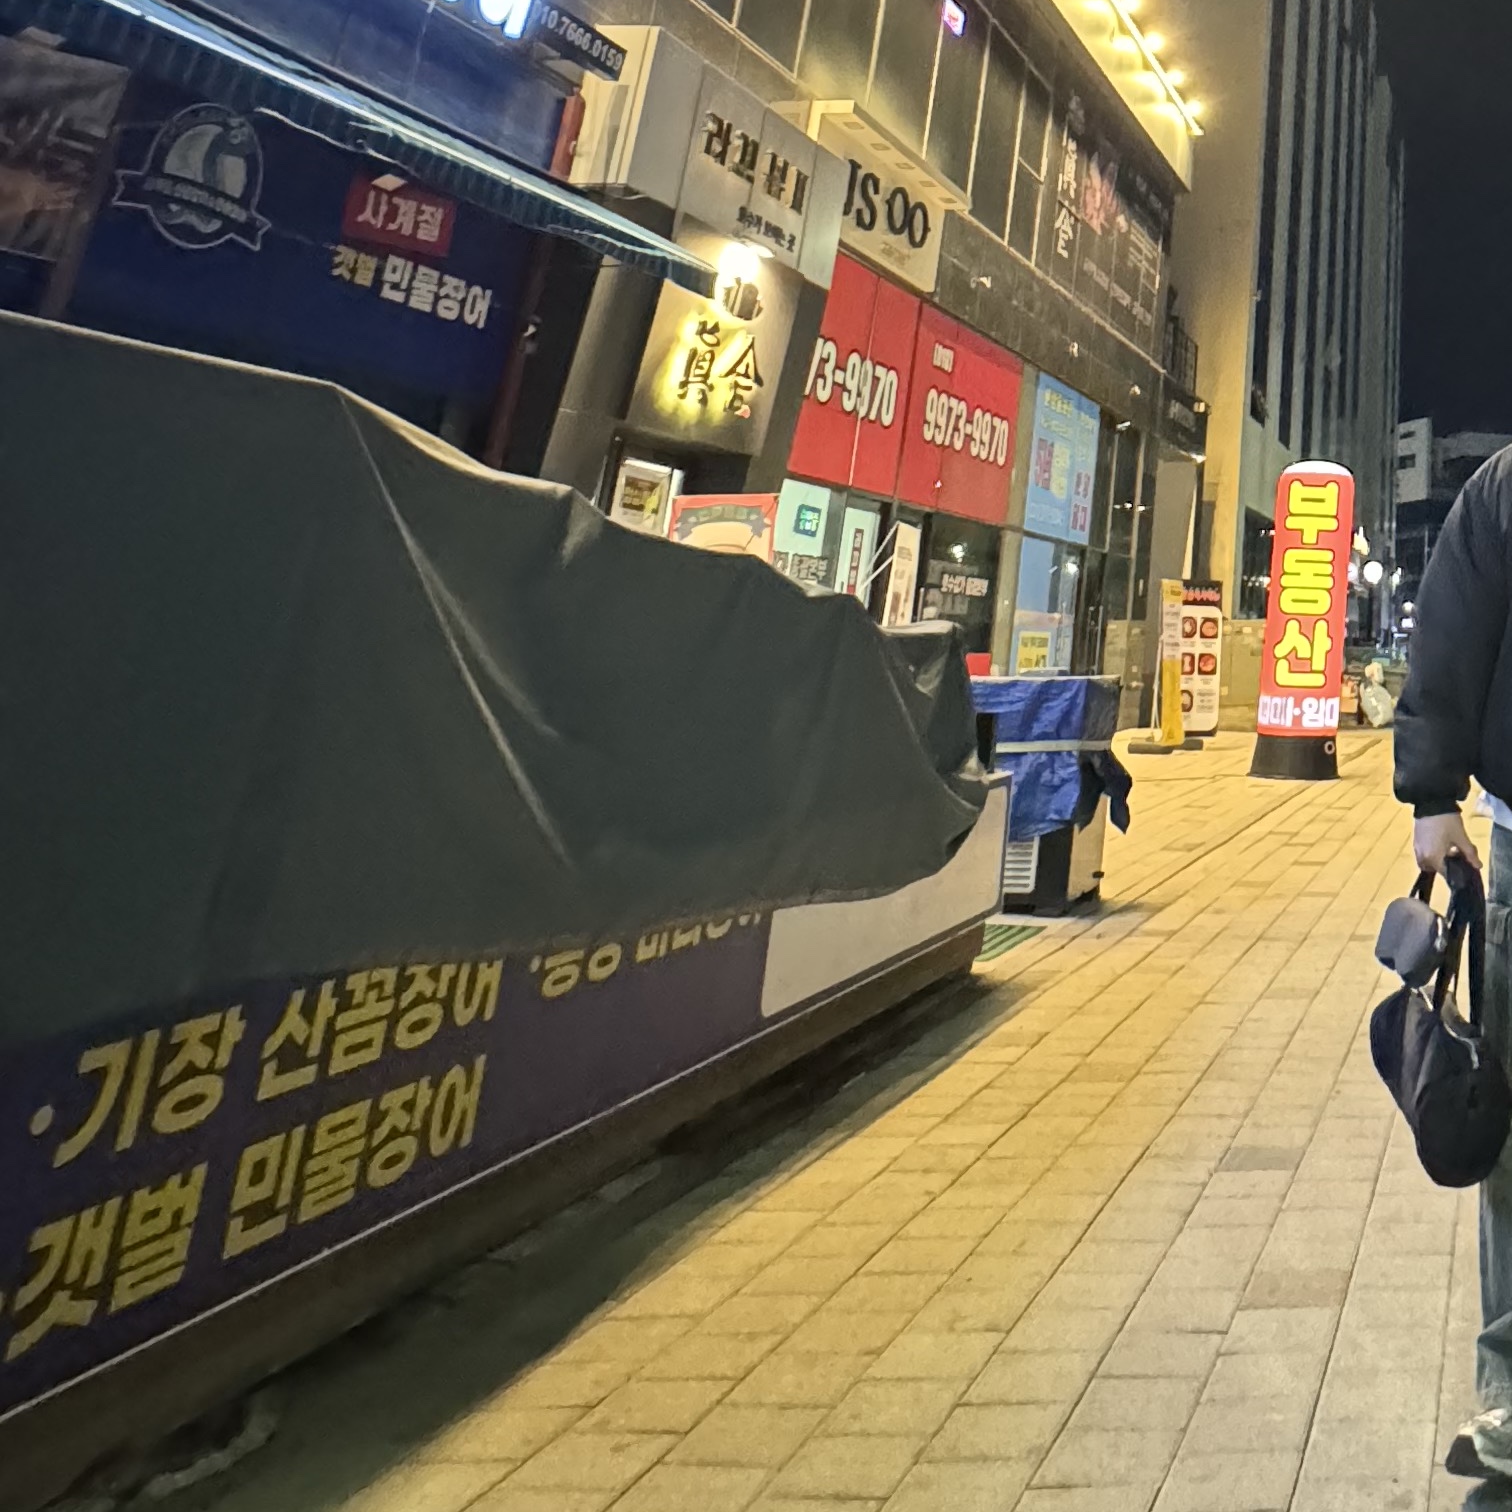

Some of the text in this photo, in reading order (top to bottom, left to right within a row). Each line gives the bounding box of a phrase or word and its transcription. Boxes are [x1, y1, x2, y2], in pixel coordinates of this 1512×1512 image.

[357, 190, 445, 242] 사계절
[379, 253, 493, 329] 민물장어
[923, 388, 1009, 466] 9973-9970
[1273, 479, 1341, 688] 부동산
[53, 960, 502, 1169] 기장 산꼼장어
[4, 1054, 487, 1362] 갯벌 민물장어
